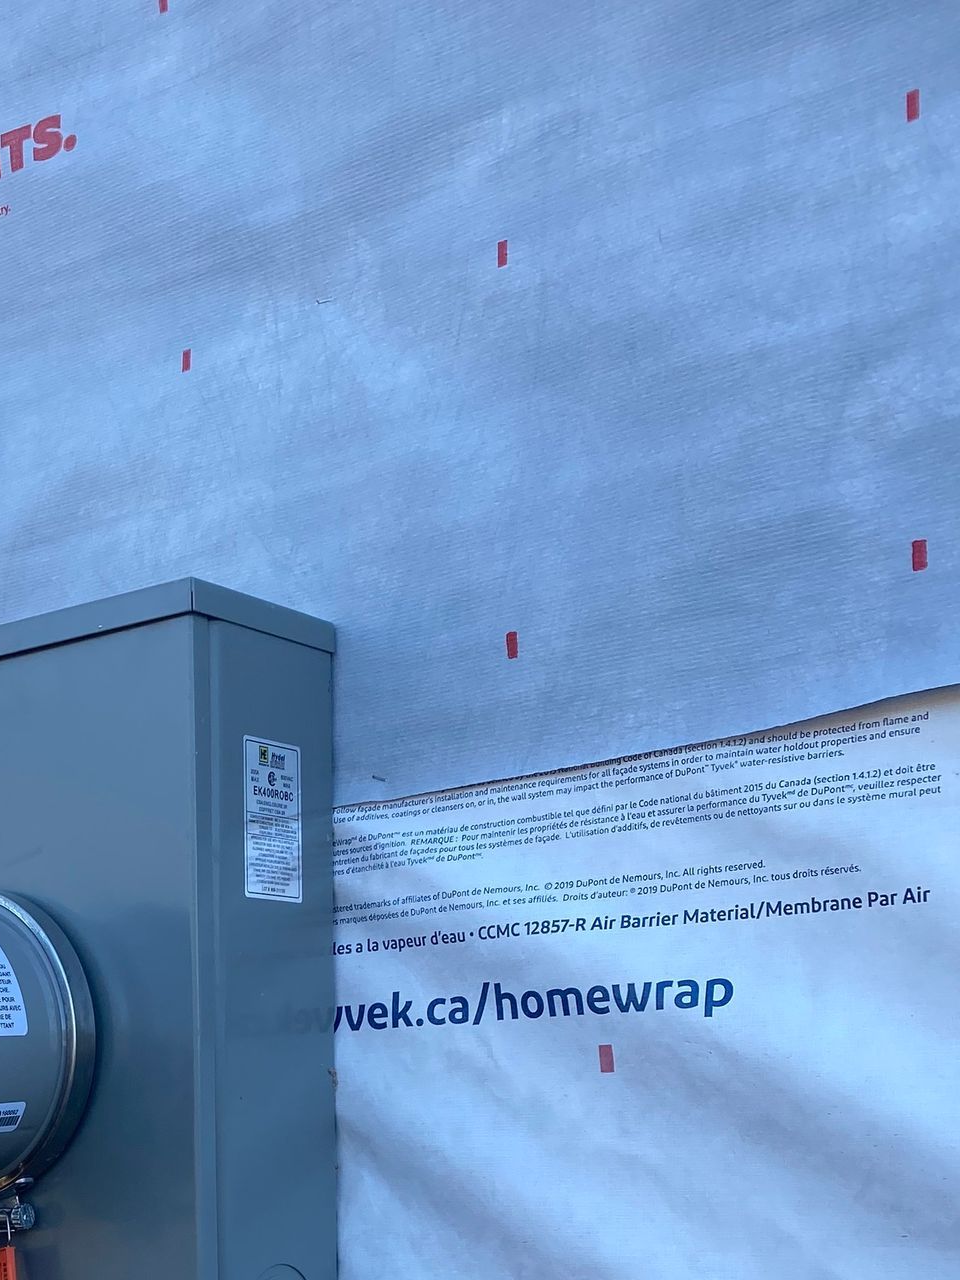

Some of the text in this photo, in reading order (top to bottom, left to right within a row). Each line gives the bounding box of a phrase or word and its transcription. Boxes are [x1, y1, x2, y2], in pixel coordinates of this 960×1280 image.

[653, 712, 929, 758] Canada (section 1.4.1.2) and should be protected from flame and
[778, 763, 935, 788] Canada (section 1.4.1.2) et doit être
[353, 897, 391, 910] trademarks
[392, 896, 400, 905] of
[400, 892, 431, 904] affiliates
[432, 890, 440, 900] of
[441, 887, 469, 898] DuPont
[471, 886, 481, 895] de
[483, 885, 522, 894] Nemours,
[525, 882, 538, 891] Inc.
[553, 879, 574, 889] 2019
[575, 876, 607, 888] DuPont
[609, 875, 620, 884] de
[622, 873, 663, 883] Nemours,
[665, 869, 680, 878] Inc.
[682, 866, 695, 876] All
[696, 864, 722, 875] rights
[724, 859, 766, 871] reserved.
[400, 908, 409, 917] de
[410, 904, 437, 916] DuPont
[438, 903, 447, 912] de
[448, 902, 484, 911] Nemours,
[486, 897, 501, 907] Inc.
[502, 895, 510, 904] et
[562, 891, 588, 901] Droits
[636, 885, 658, 894] 2019
[659, 881, 692, 893] DuPont
[694, 880, 705, 889] de
[707, 878, 751, 888] Nemours,
[752, 874, 768, 883] Inc.
[770, 872, 790, 881] tous
[792, 868, 819, 879] droits
[820, 864, 861, 876] réservés.
[355, 942, 362, 953] a
[366, 937, 378, 952] la
[382, 934, 426, 952] vapeur
[430, 929, 465, 945] d'eau
[477, 922, 520, 940] CCMC
[524, 916, 586, 935] 12857-R
[590, 915, 616, 930] Air
[620, 912, 678, 928] Barrier
[683, 897, 862, 924] Material/Membrane
[867, 892, 897, 907] Par
[902, 888, 930, 904] Air
